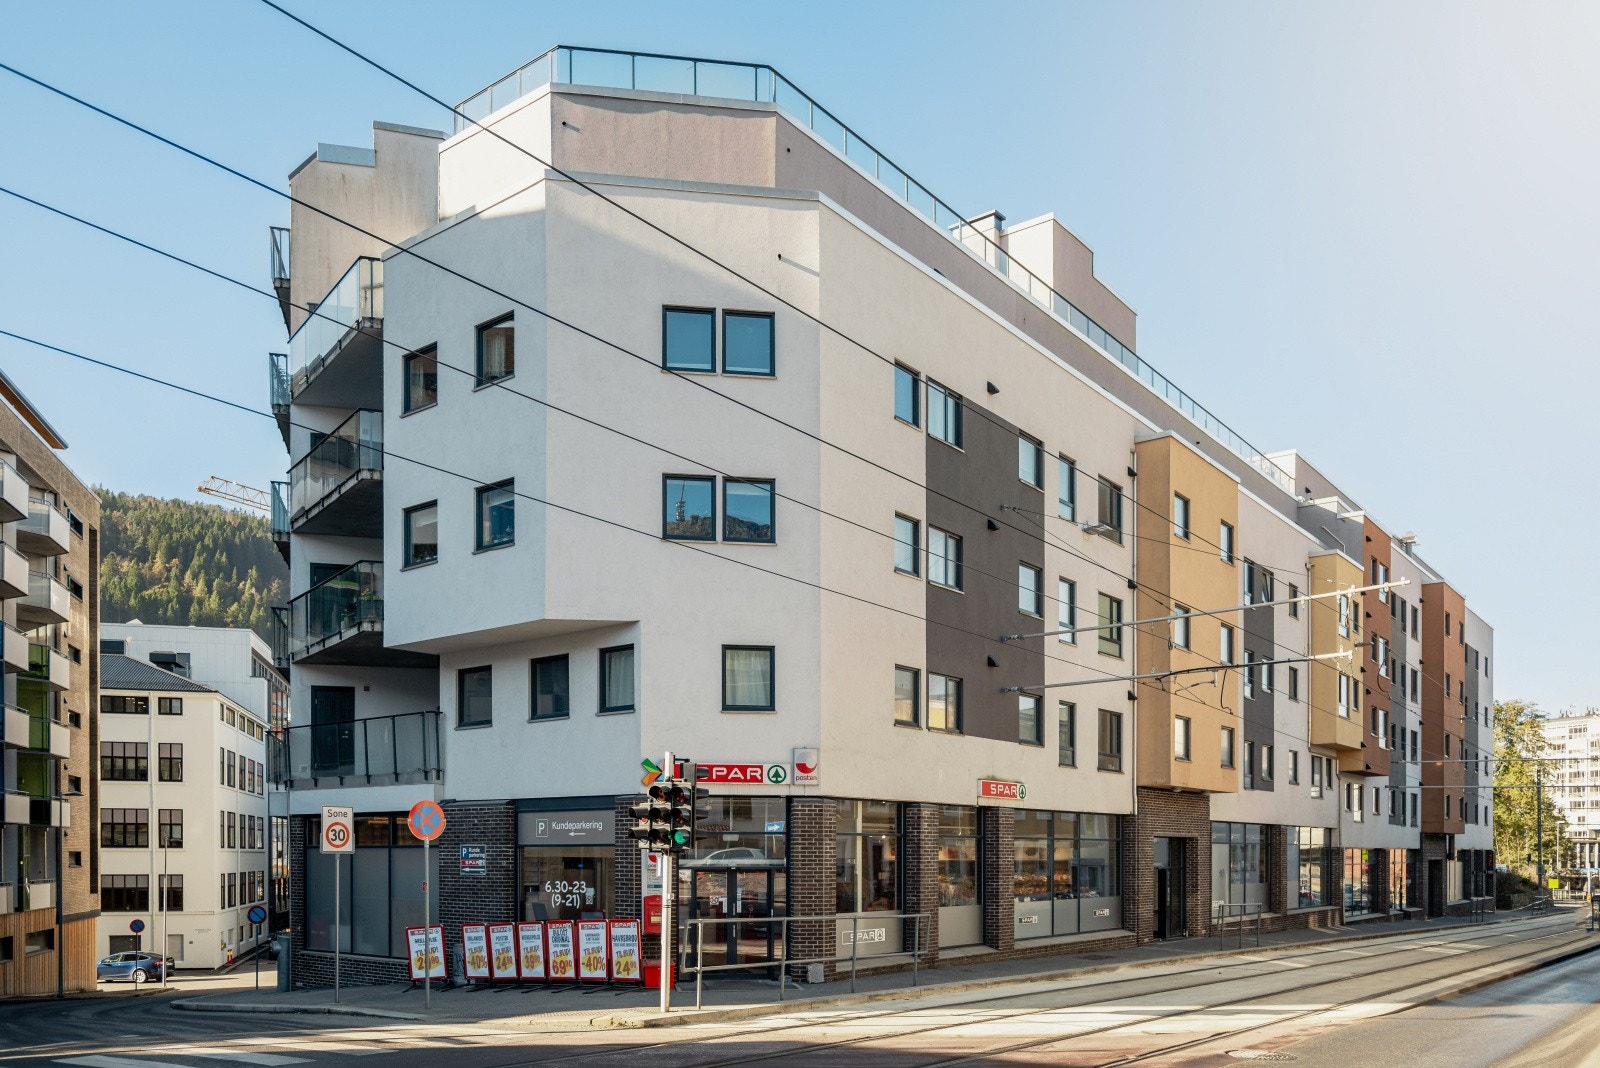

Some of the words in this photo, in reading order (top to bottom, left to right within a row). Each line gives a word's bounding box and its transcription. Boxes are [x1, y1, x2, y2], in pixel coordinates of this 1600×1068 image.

[698, 767, 762, 780] PAR
[990, 784, 1017, 795] SPAR
[327, 809, 348, 818] Sone
[538, 822, 545, 834] P
[551, 821, 603, 831] Kundeparkering
[330, 829, 346, 842] 30
[545, 881, 587, 893] 6.30-23
[551, 894, 580, 909] (9-21)
[467, 955, 488, 971] -40%
[581, 956, 606, 972] -40%
